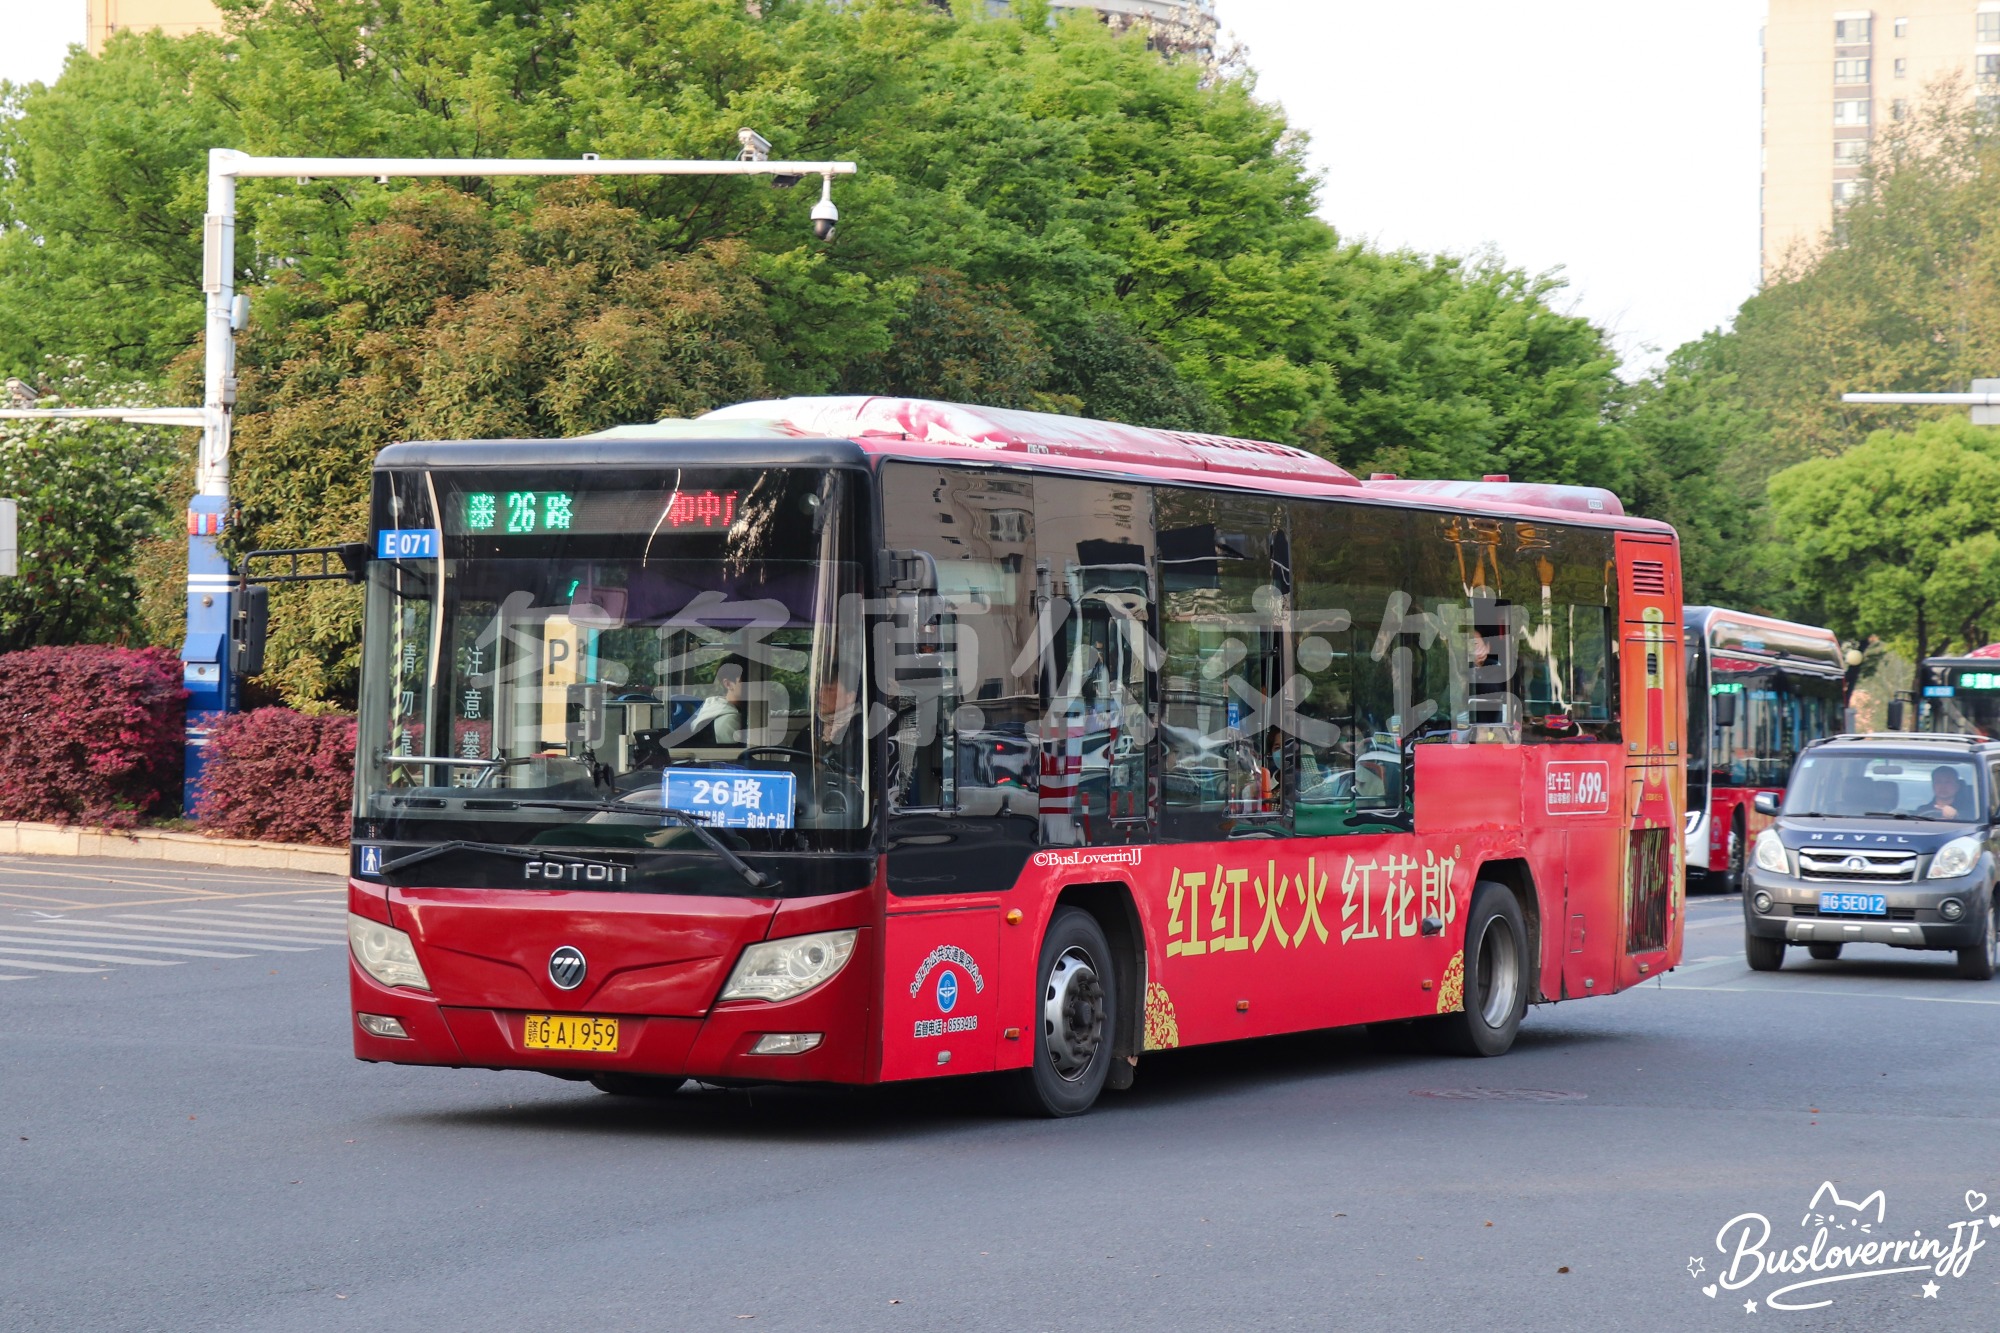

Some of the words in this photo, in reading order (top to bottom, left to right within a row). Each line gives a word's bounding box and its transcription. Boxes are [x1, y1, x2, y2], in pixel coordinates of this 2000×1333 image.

[692, 779, 763, 809] 26路
[1811, 833, 1910, 843] HAVAL
[1166, 857, 1329, 958] 红红火火
